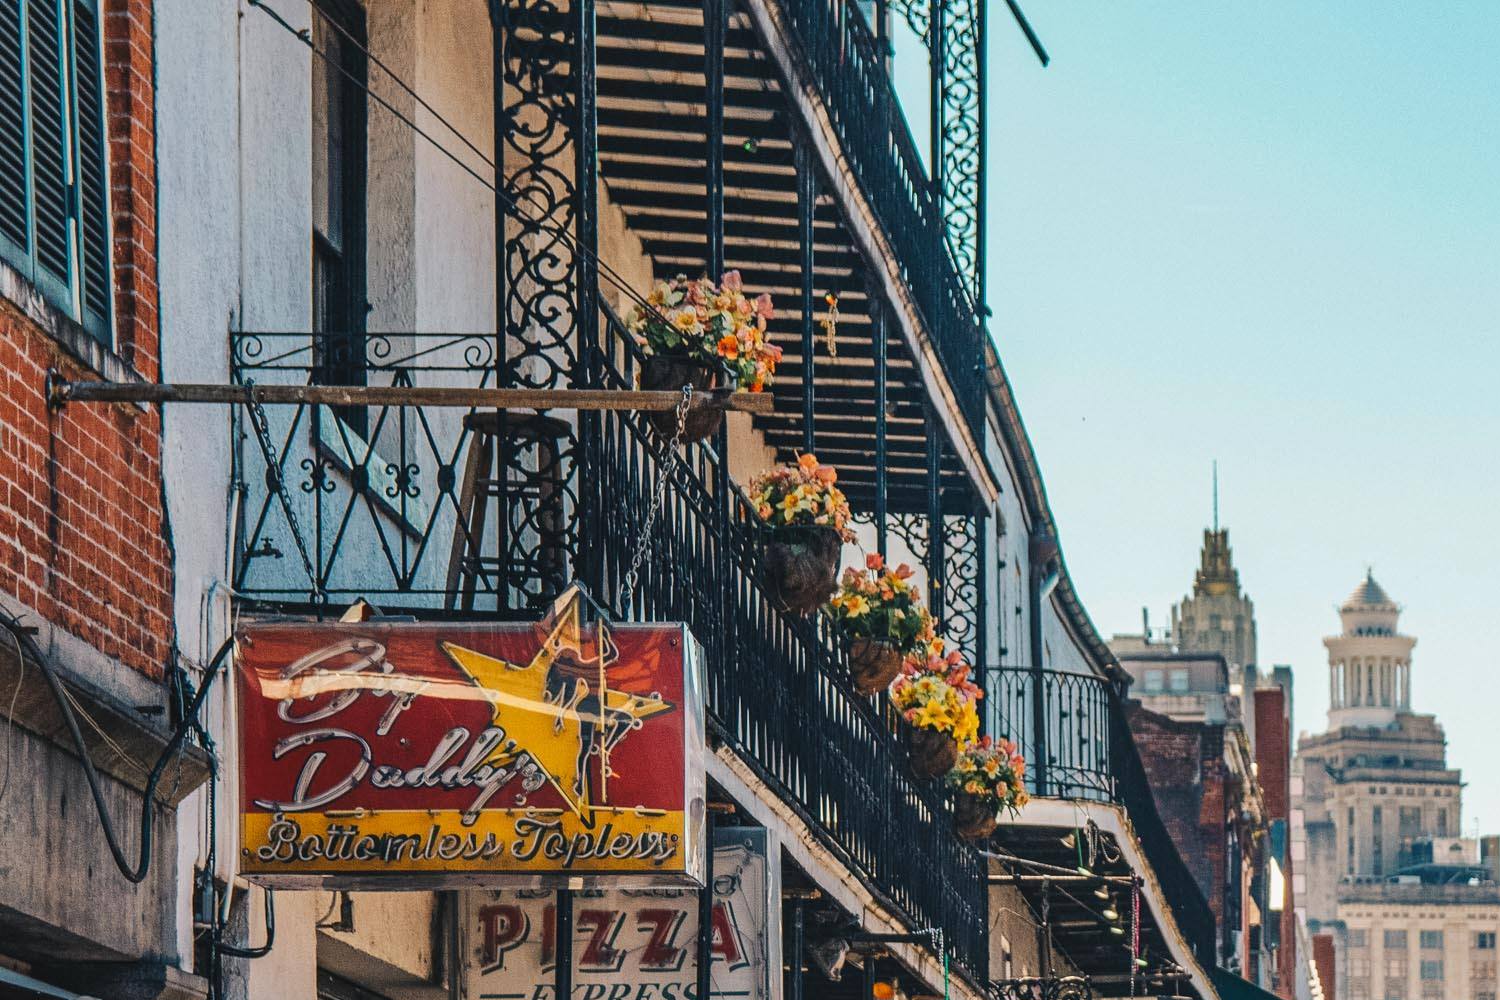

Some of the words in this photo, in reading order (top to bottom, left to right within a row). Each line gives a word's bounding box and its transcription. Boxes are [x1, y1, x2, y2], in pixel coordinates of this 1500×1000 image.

[254, 727, 547, 826] Daddy's
[257, 821, 503, 863] Bottomless
[510, 817, 679, 869] Topless
